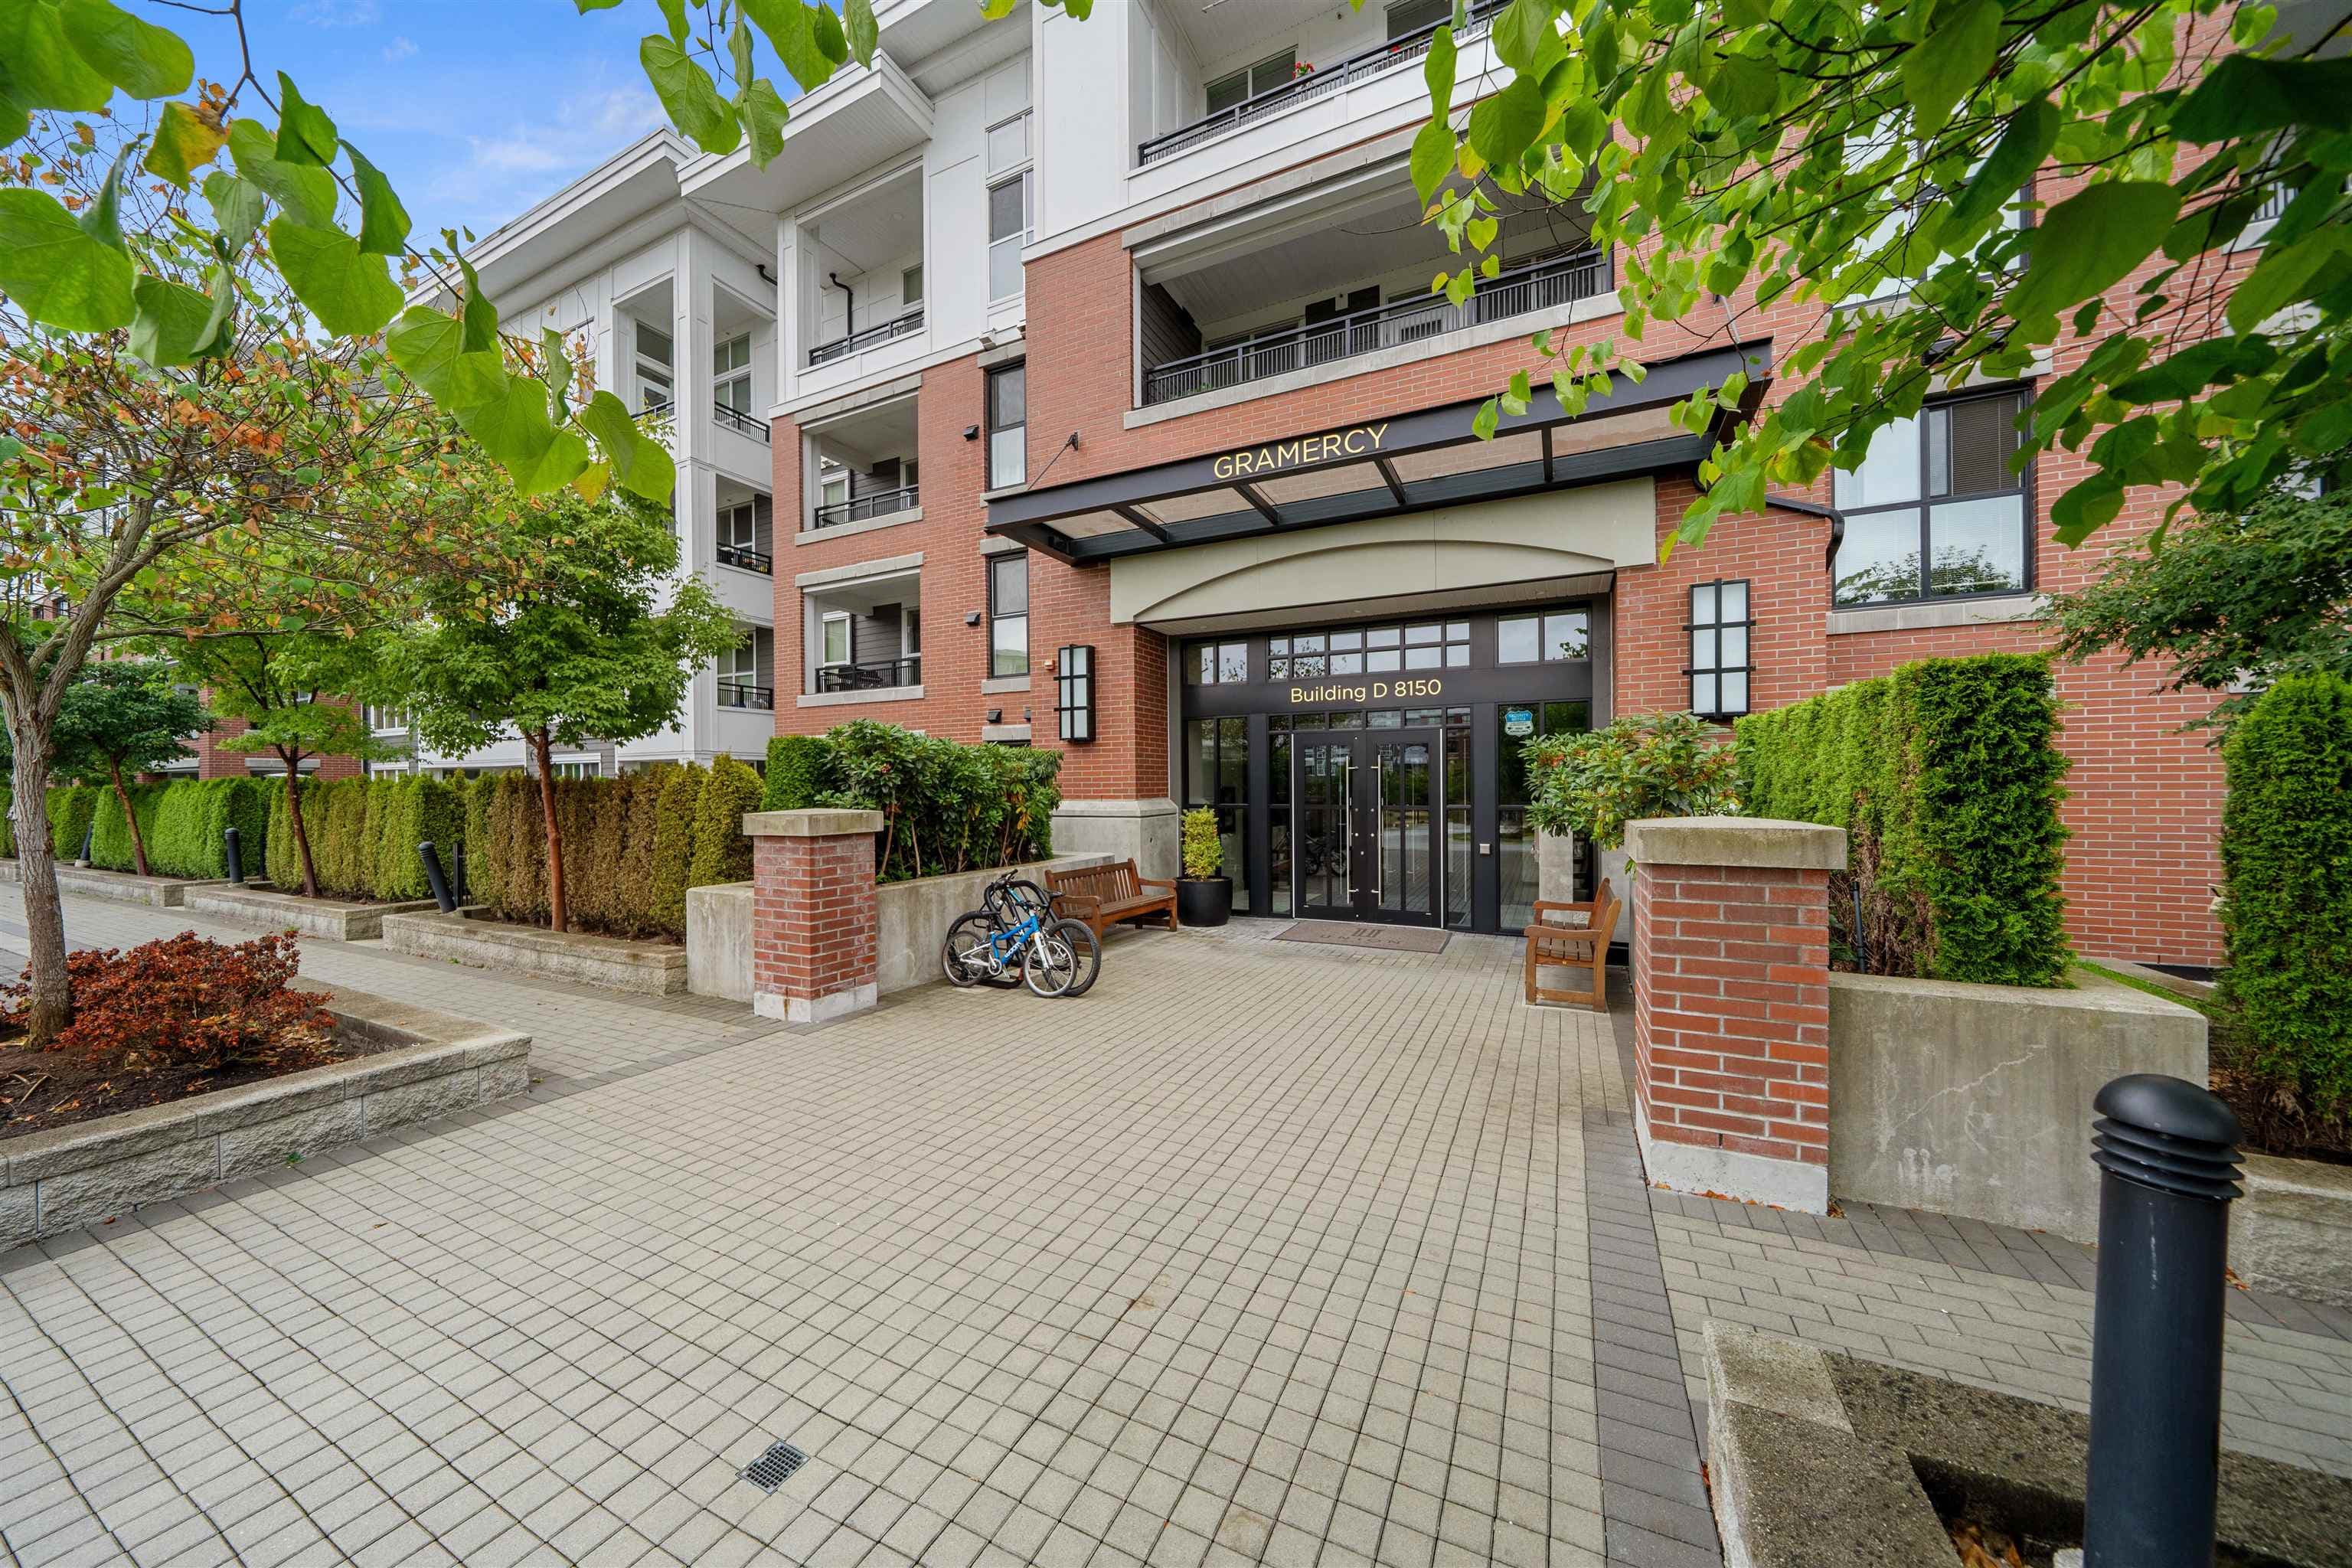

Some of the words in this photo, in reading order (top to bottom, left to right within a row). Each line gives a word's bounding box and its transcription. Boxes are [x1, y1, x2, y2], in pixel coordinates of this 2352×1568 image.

[1214, 423, 1388, 479] GRAMERCY
[1291, 685, 1366, 703] Building
[1374, 683, 1388, 698] D
[1394, 679, 1442, 697] 8150
[1319, 934, 1402, 944] UNION
